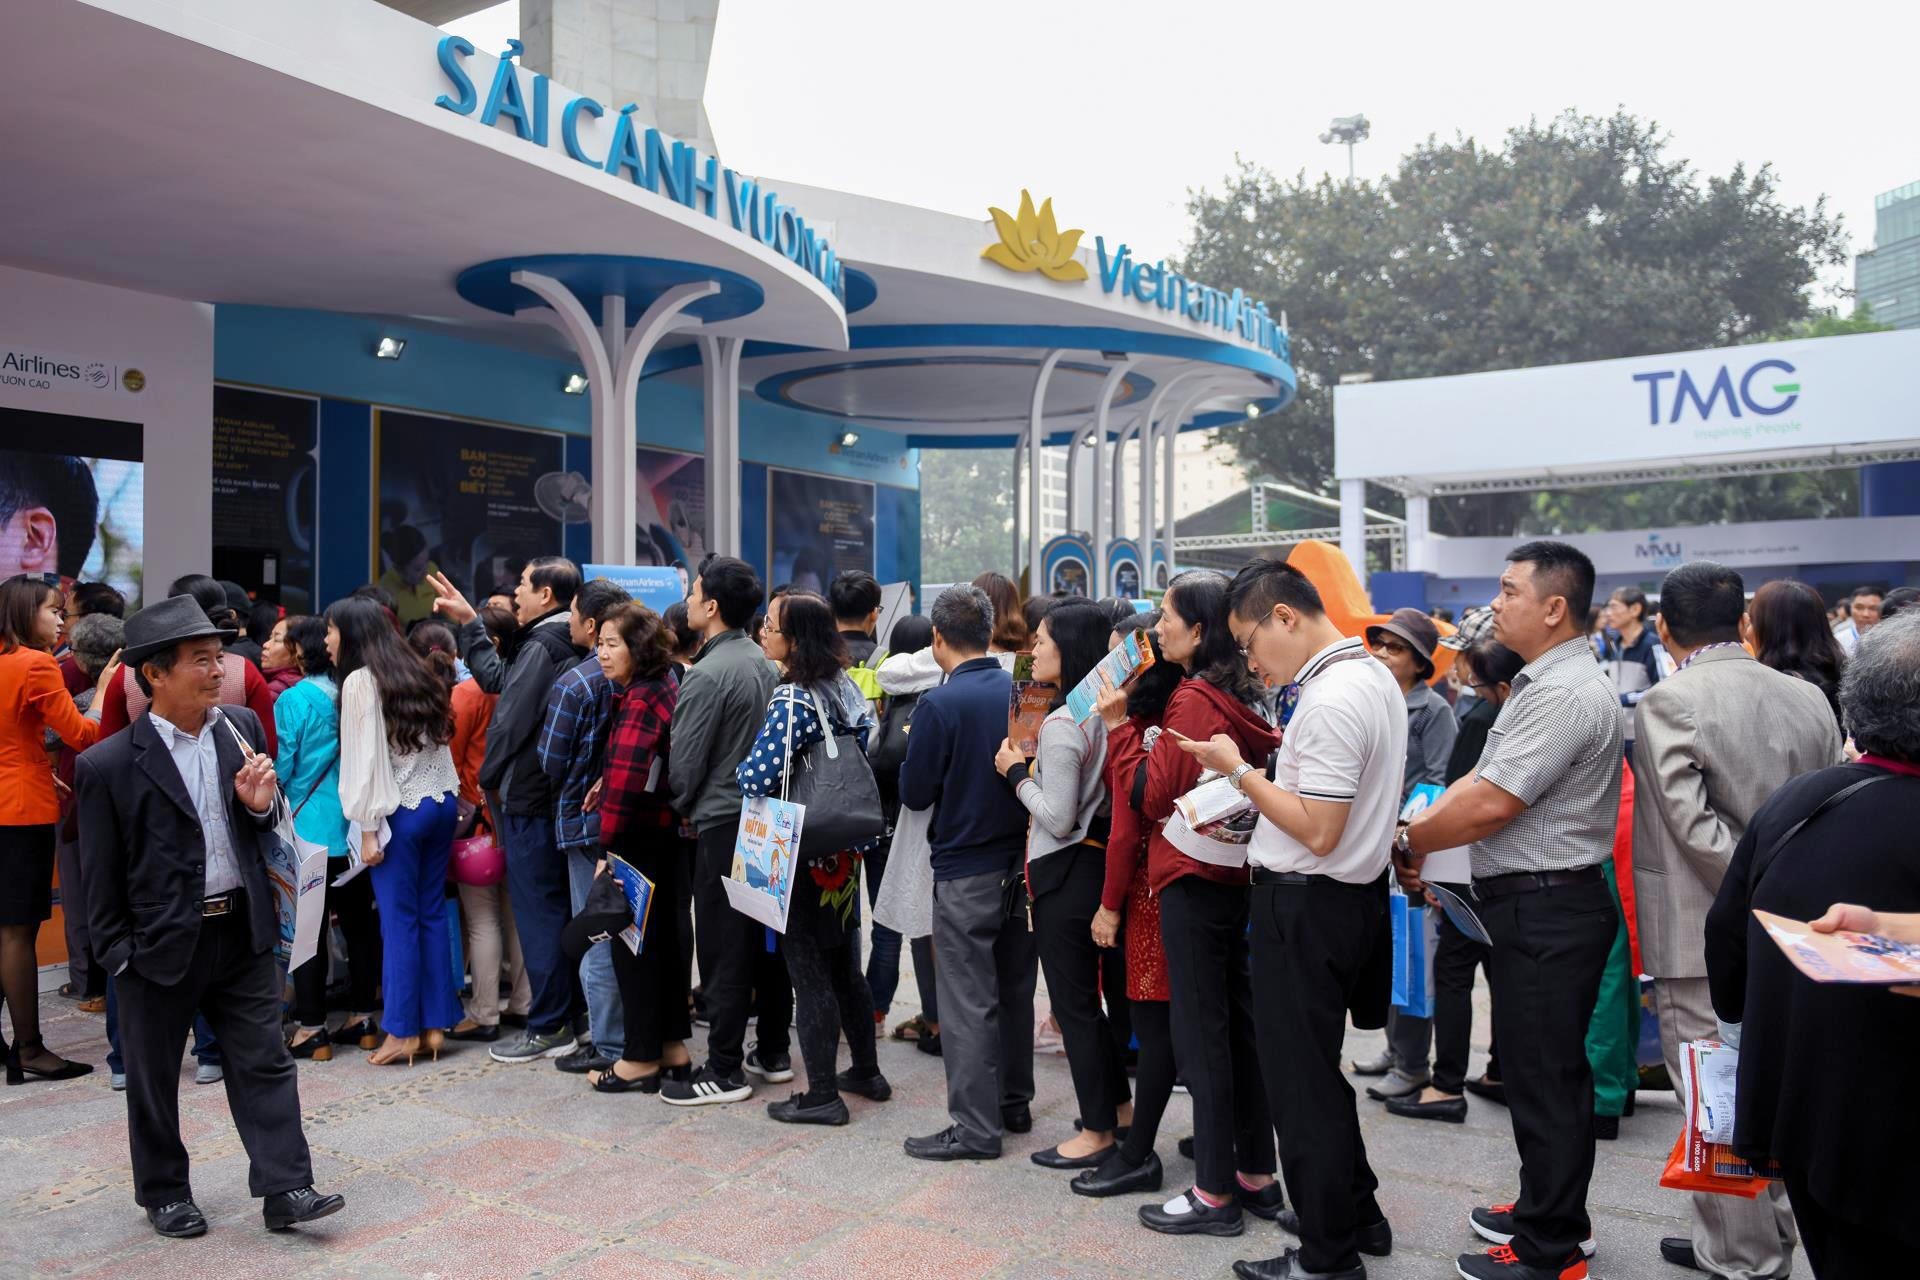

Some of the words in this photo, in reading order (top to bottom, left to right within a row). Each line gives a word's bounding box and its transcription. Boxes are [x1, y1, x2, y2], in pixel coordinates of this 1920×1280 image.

[435, 36, 549, 147] SẢI
[561, 96, 718, 219] CÁNH
[2, 352, 80, 379] Airlines
[1633, 359, 1800, 425] TMG
